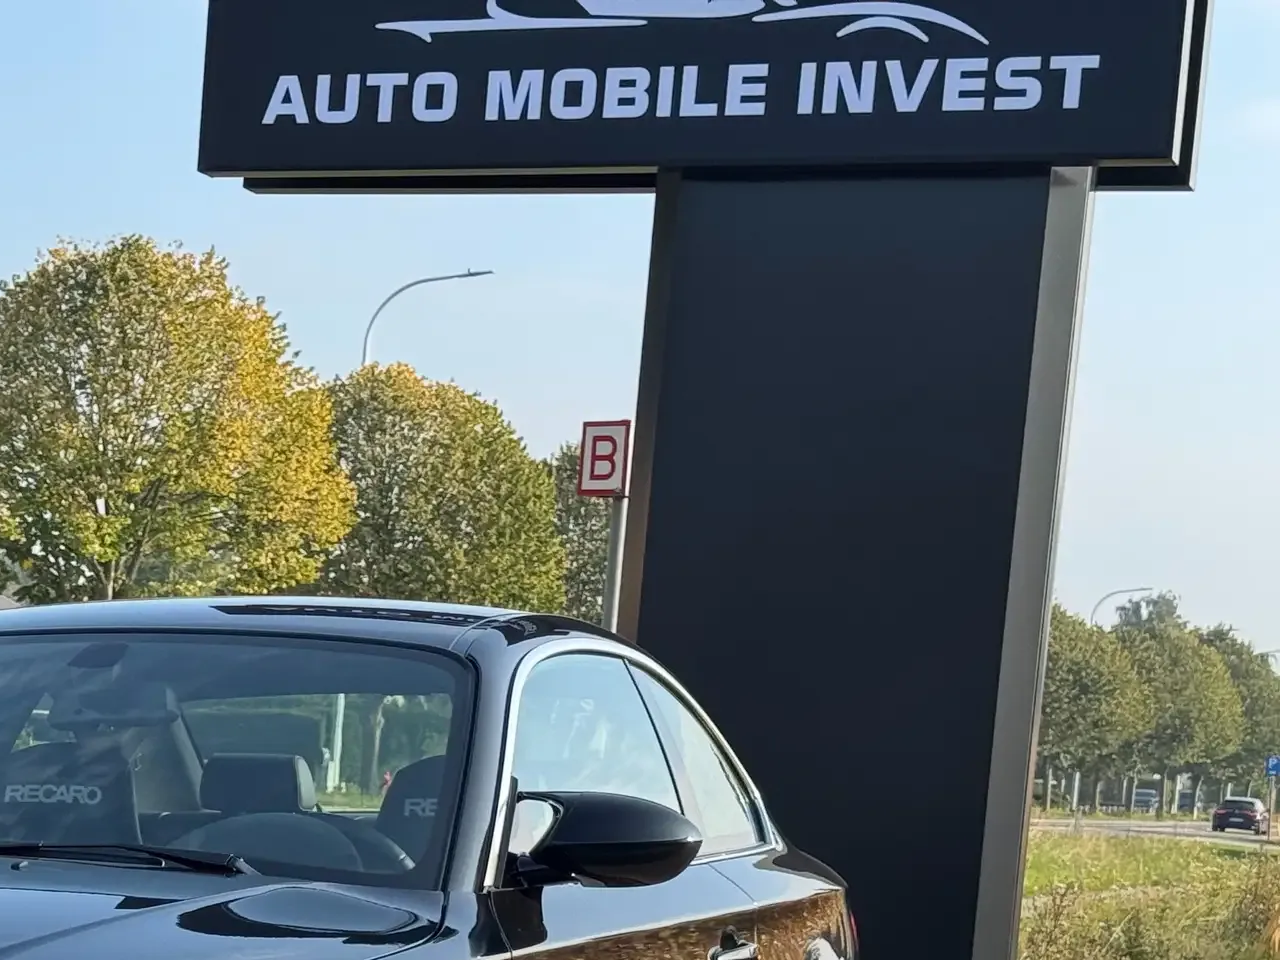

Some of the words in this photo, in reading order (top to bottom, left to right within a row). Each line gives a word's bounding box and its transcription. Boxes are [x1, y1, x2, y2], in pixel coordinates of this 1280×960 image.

[261, 72, 458, 125] AUTO
[484, 63, 769, 121] MOBILE
[796, 54, 1101, 115] INVEST
[589, 435, 618, 481] B
[4, 784, 102, 805] RECARO
